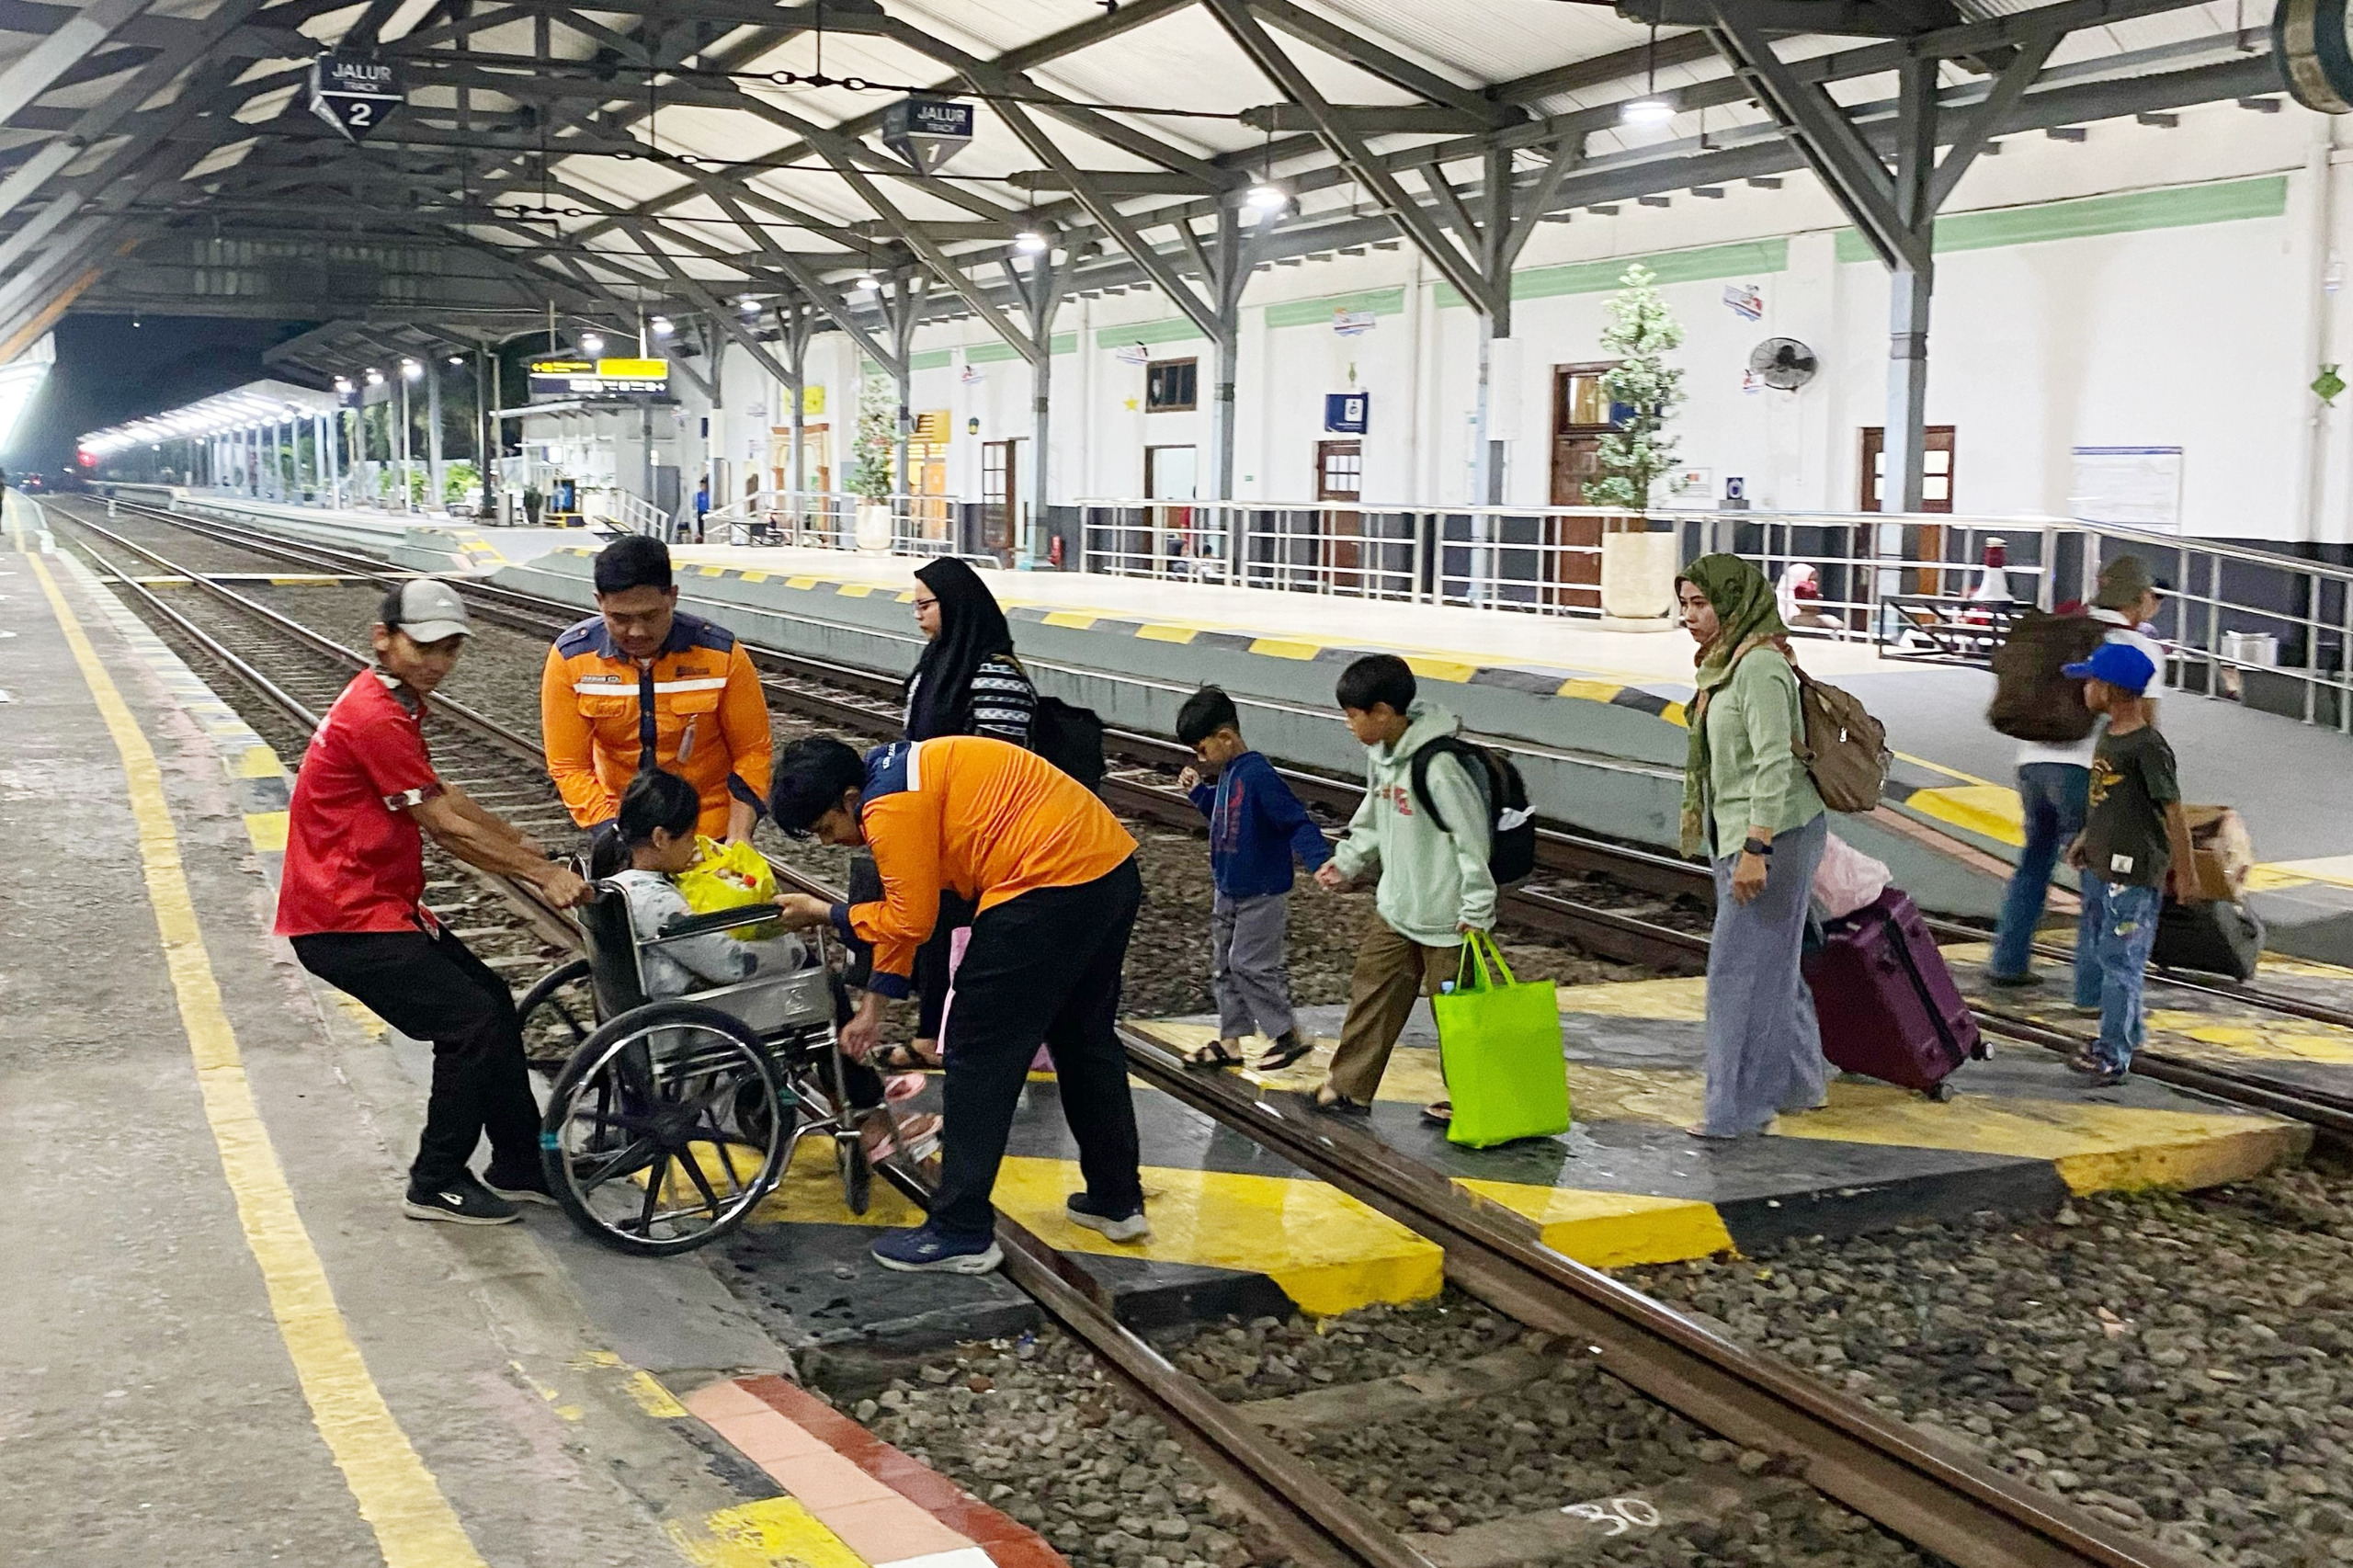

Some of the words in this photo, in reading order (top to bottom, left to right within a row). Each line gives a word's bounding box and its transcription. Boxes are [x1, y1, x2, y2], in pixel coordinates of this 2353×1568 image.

[332, 63, 392, 81] JALUR
[349, 103, 371, 126] 2
[917, 106, 966, 122] JALUR
[927, 143, 940, 164] 1
[1561, 1497, 1661, 1536] 30
